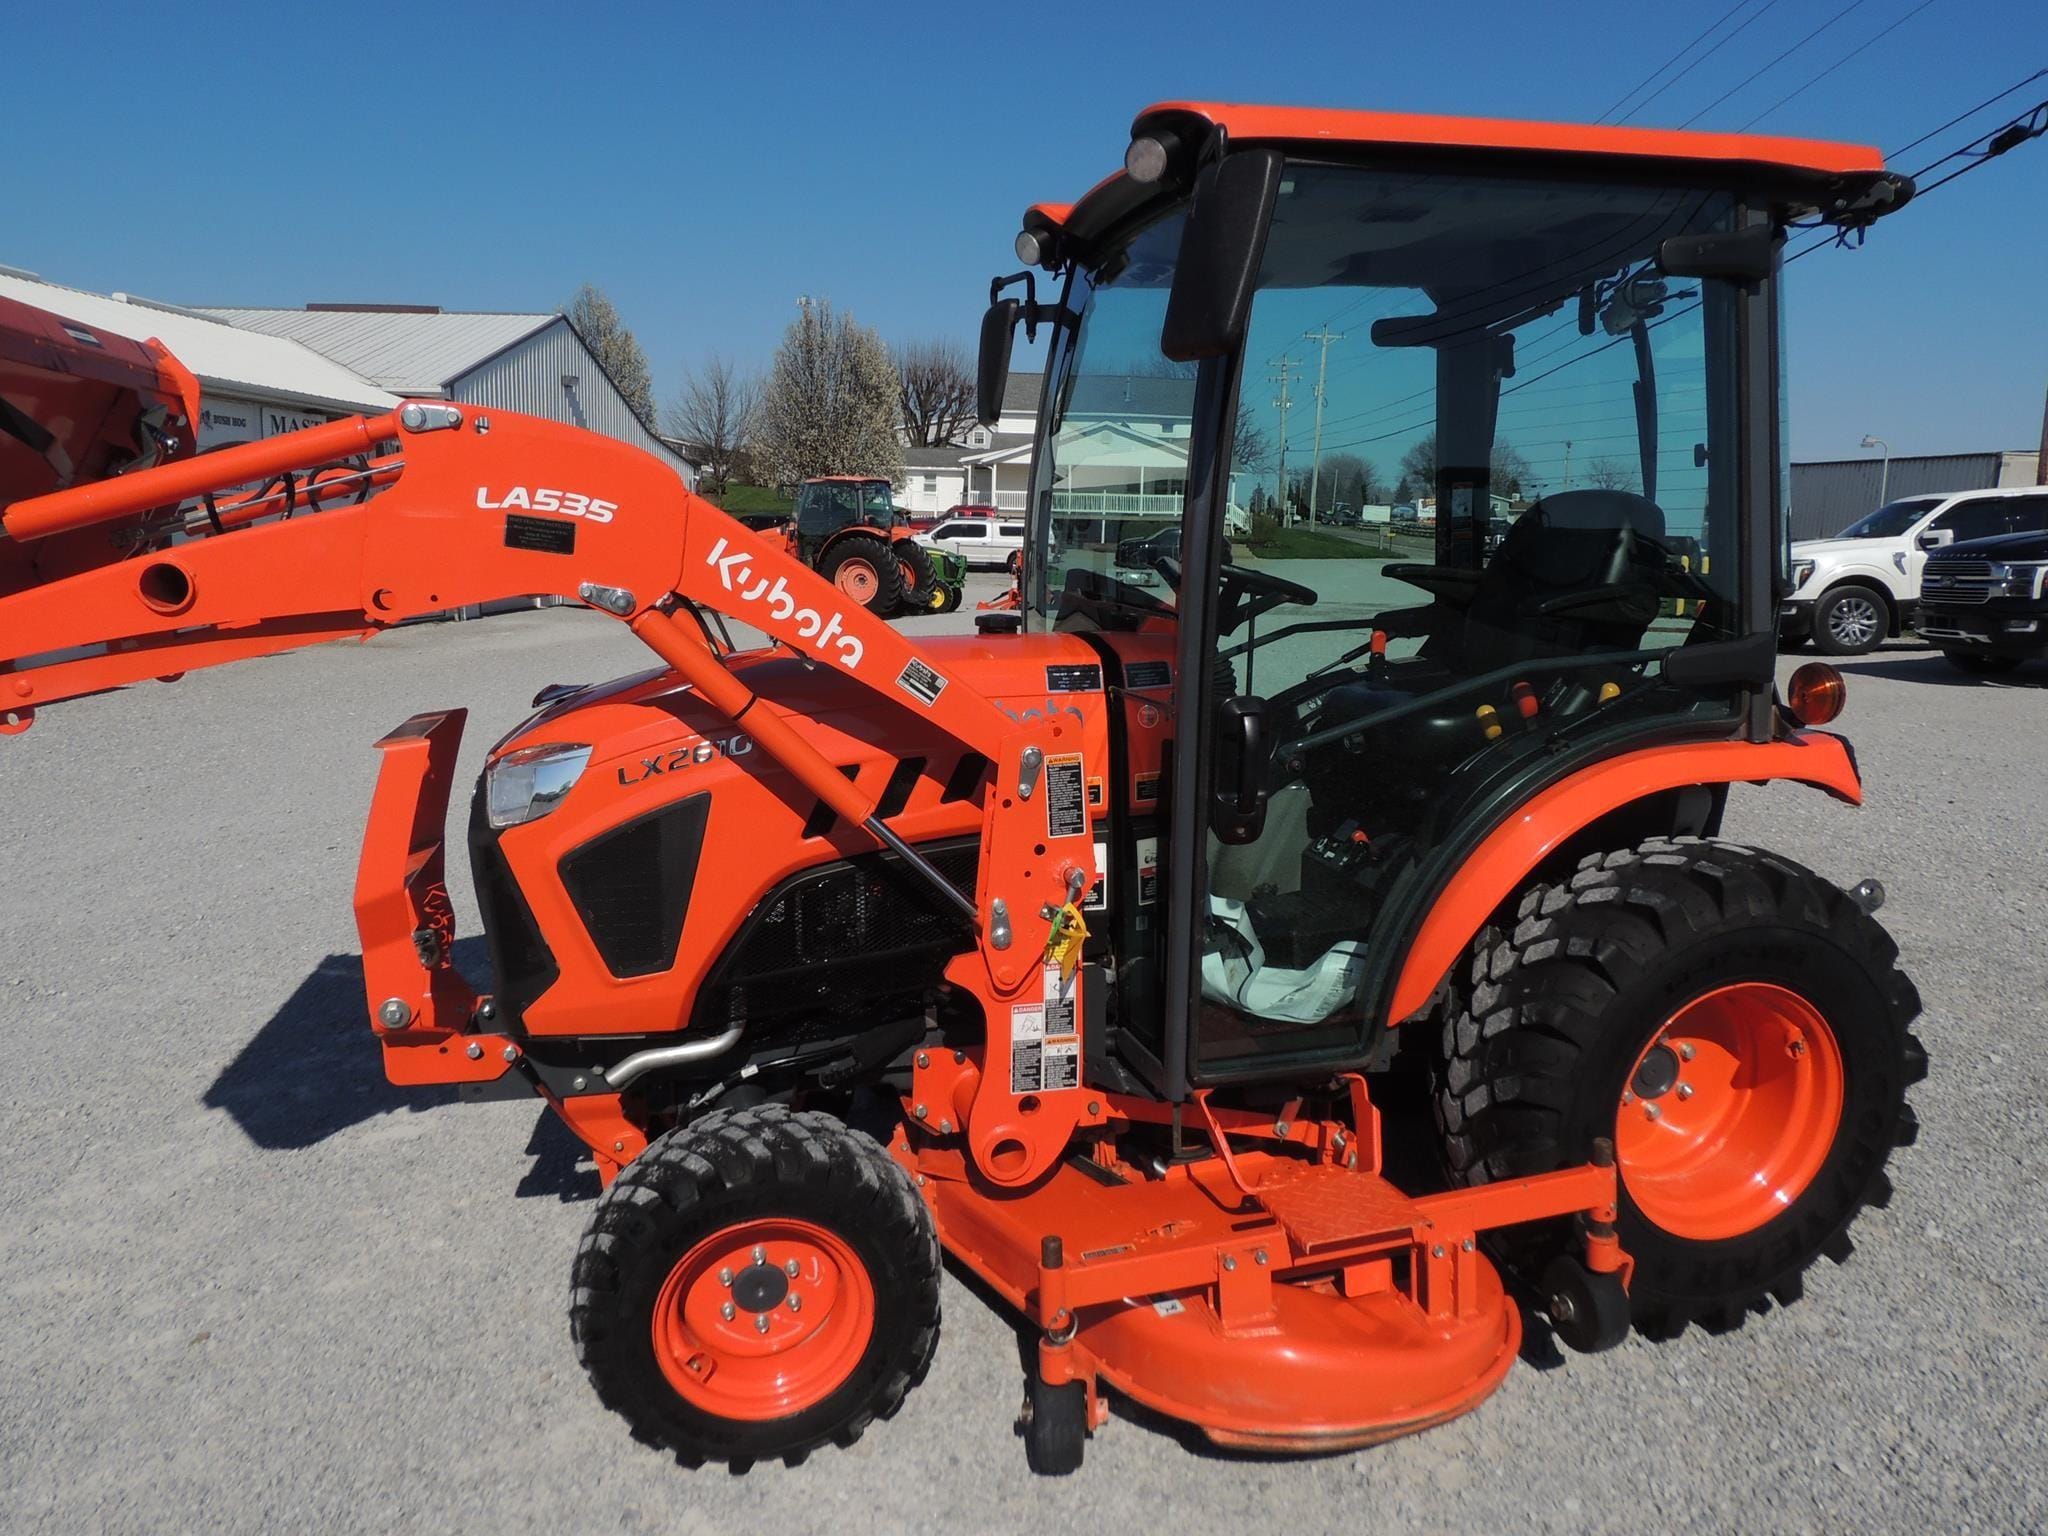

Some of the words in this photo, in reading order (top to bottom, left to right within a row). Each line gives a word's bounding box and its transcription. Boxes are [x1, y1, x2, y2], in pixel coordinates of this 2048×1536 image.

[476, 486, 619, 524] LA535
[706, 537, 864, 670] Kubota
[617, 733, 753, 786] LX2610
